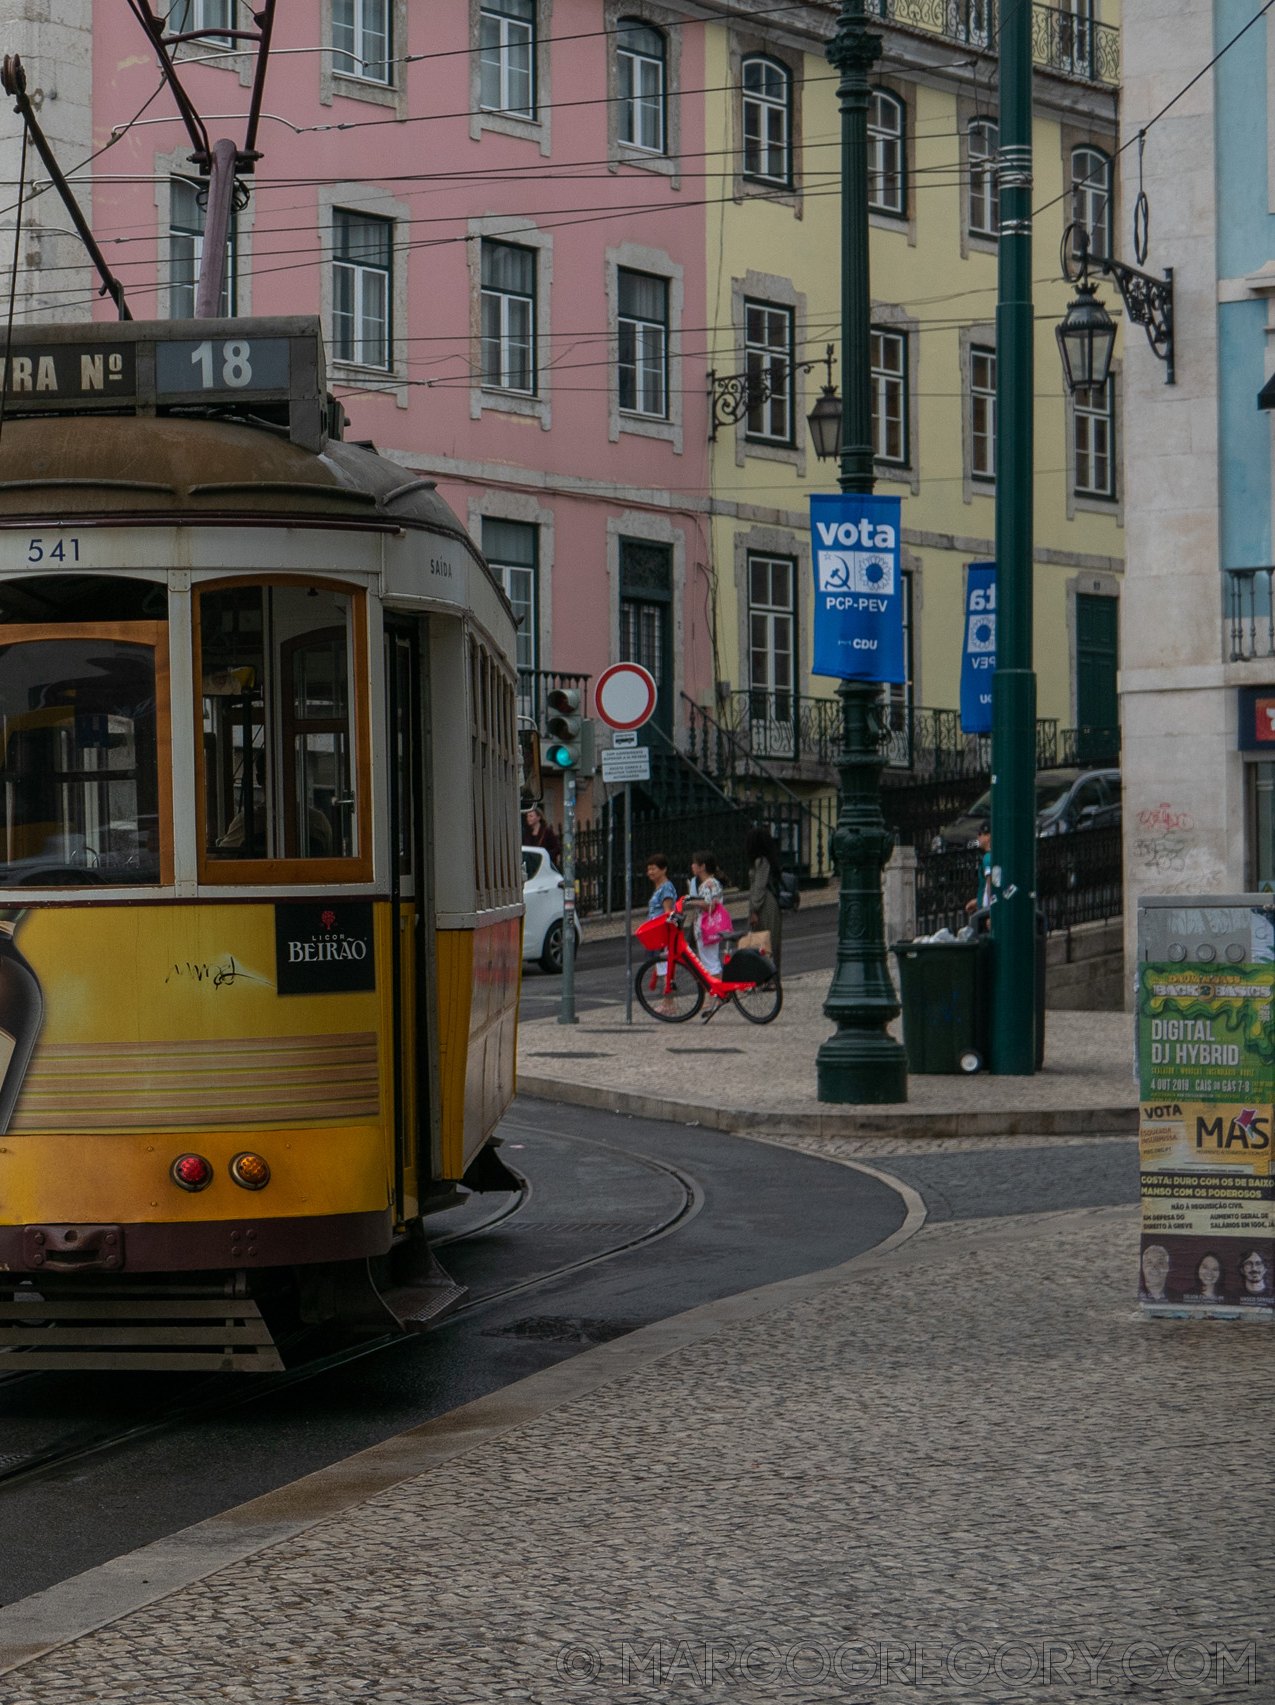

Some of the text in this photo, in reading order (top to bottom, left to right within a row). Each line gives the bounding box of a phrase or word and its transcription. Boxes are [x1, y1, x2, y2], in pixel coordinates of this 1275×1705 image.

[190, 338, 253, 390] 18
[81, 353, 123, 391] Nº
[815, 518, 896, 548] vota
[28, 539, 79, 562] 541
[431, 555, 453, 579] SAÍDA
[826, 597, 888, 612] PCP-PEV
[853, 638, 878, 650] CDU
[311, 934, 346, 942] LICOR
[287, 937, 367, 963] BEIRÃO
[1153, 984, 1199, 997] BACK
[1214, 985, 1272, 998] BASICS
[1151, 1019, 1216, 1041] DIGITAL
[1151, 1042, 1240, 1065] DJ HYBRID
[1151, 1078, 1156, 1091] 4
[1157, 1078, 1171, 1091] OUT
[1172, 1079, 1191, 1091] 2019
[1195, 1079, 1213, 1092] CAIS
[1144, 1104, 1183, 1119] VOTA
[1197, 1116, 1270, 1149] MAS
[1141, 1175, 1275, 1188] COSTA: DURO COM OS DE BAIXO
[1141, 1186, 1262, 1198] MANSO COM OS PODEROSOS
[1171, 1202, 1184, 1210] NÃO
[1210, 1221, 1240, 1229] SALÁRIOS
